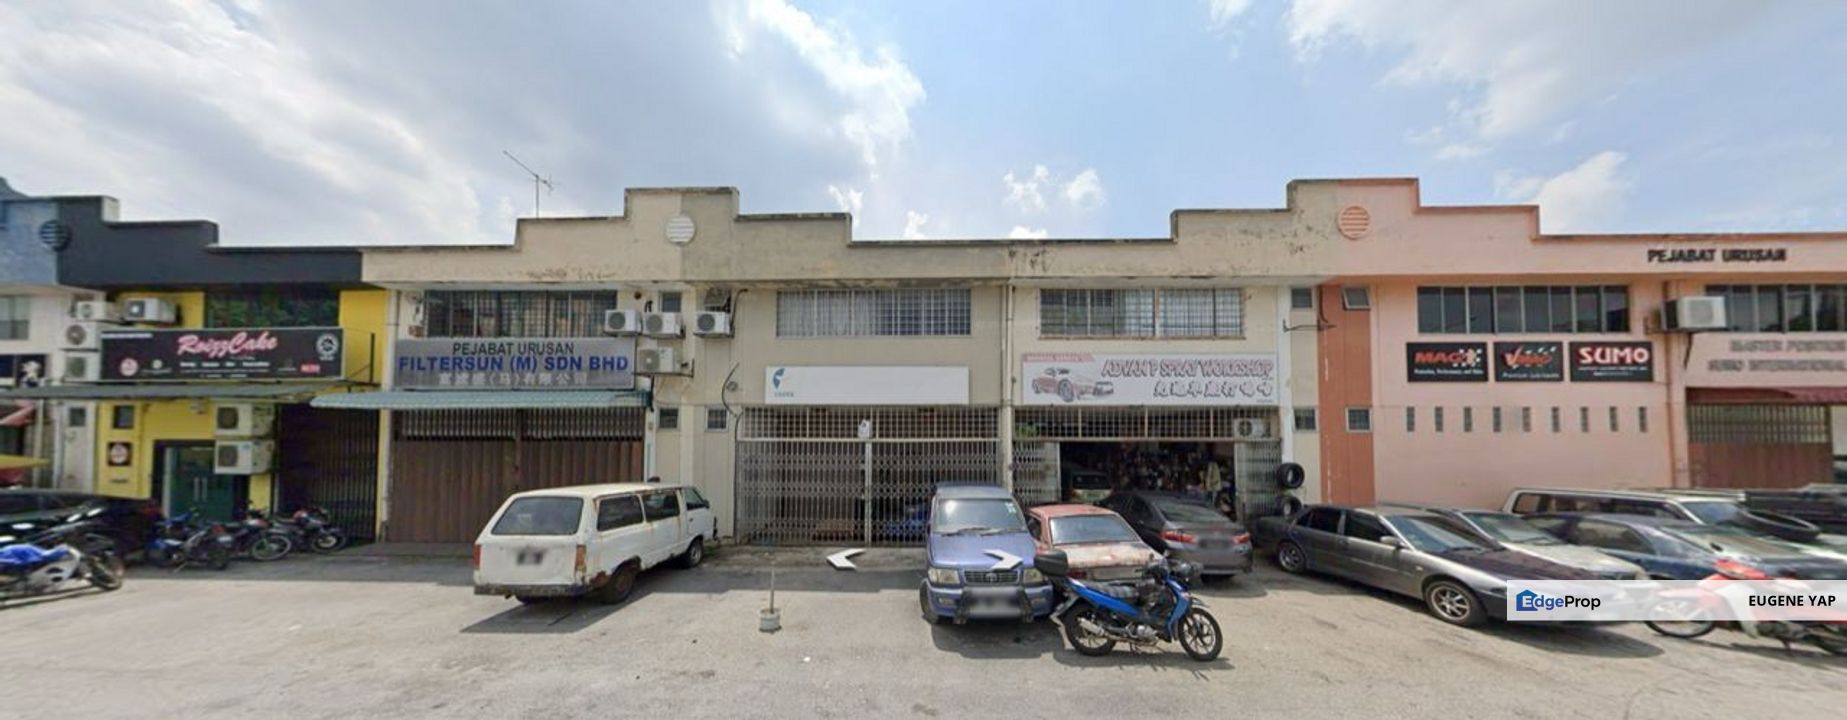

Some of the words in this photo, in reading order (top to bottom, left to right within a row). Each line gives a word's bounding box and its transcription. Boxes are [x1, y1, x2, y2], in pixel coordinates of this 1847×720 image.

[1647, 248, 1717, 263] PEJABAT
[1722, 248, 1787, 263] URUSAN
[452, 342, 514, 356] PEJABAT
[518, 342, 575, 356] URUSAN
[1578, 347, 1649, 365] SUMO
[398, 356, 504, 371] FILTERSUN
[510, 356, 538, 373] (M)
[544, 356, 583, 371] SDN
[589, 356, 628, 371] BHD
[1198, 359, 1273, 378] WORKSHOP
